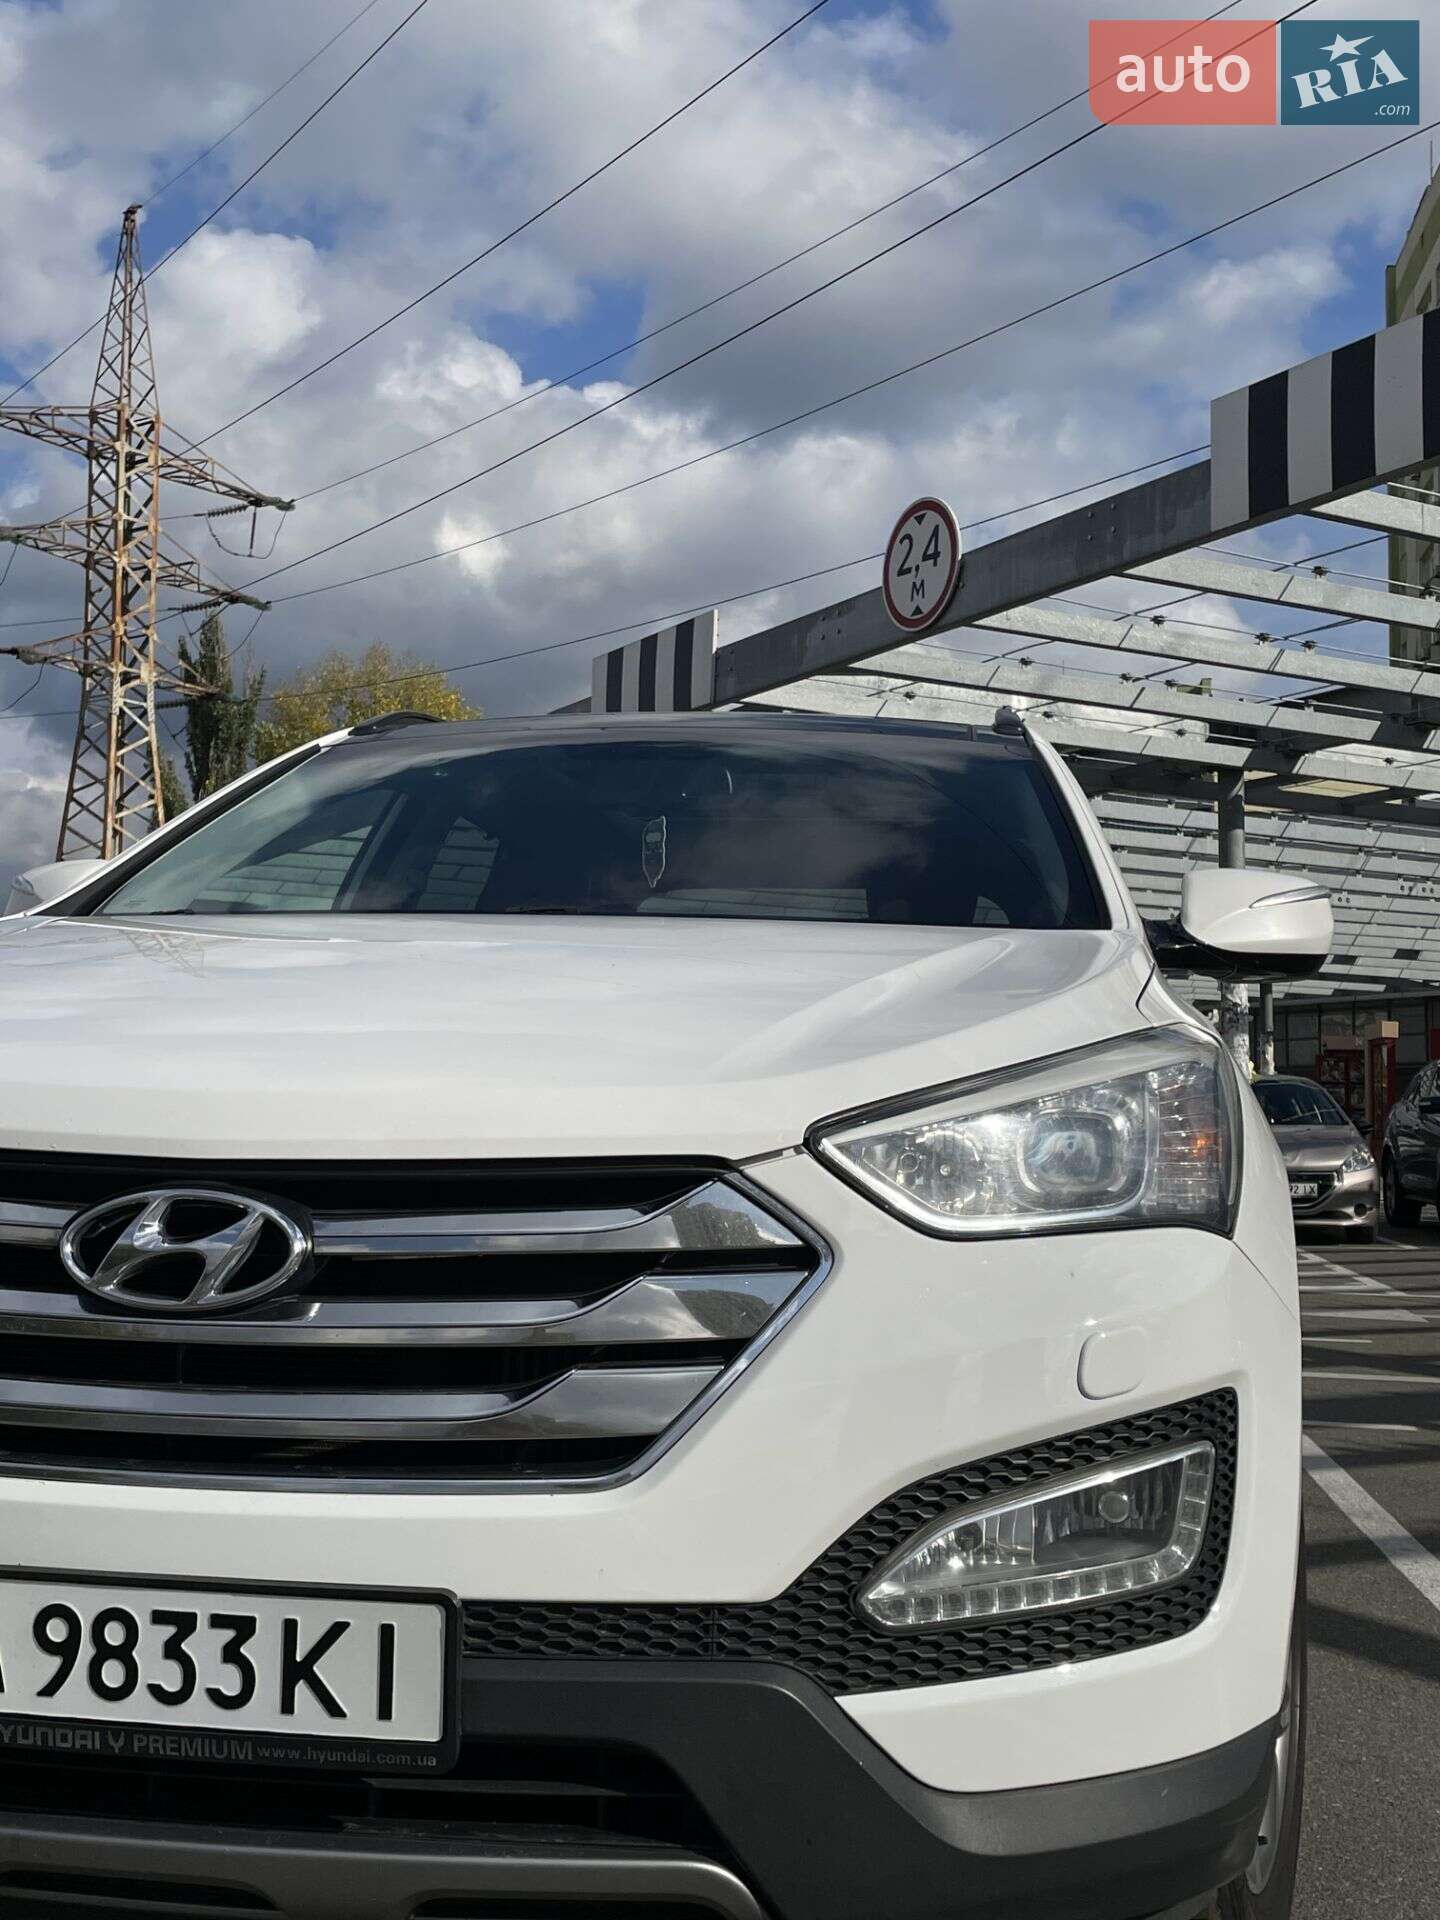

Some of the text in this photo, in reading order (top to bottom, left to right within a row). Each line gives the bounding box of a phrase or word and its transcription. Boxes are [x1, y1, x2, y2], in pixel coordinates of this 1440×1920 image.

[896, 524, 942, 578] 2,4
[133, 1734, 253, 1761] PREMIUM
[256, 1744, 437, 1767] www.hyundai.com.ua
